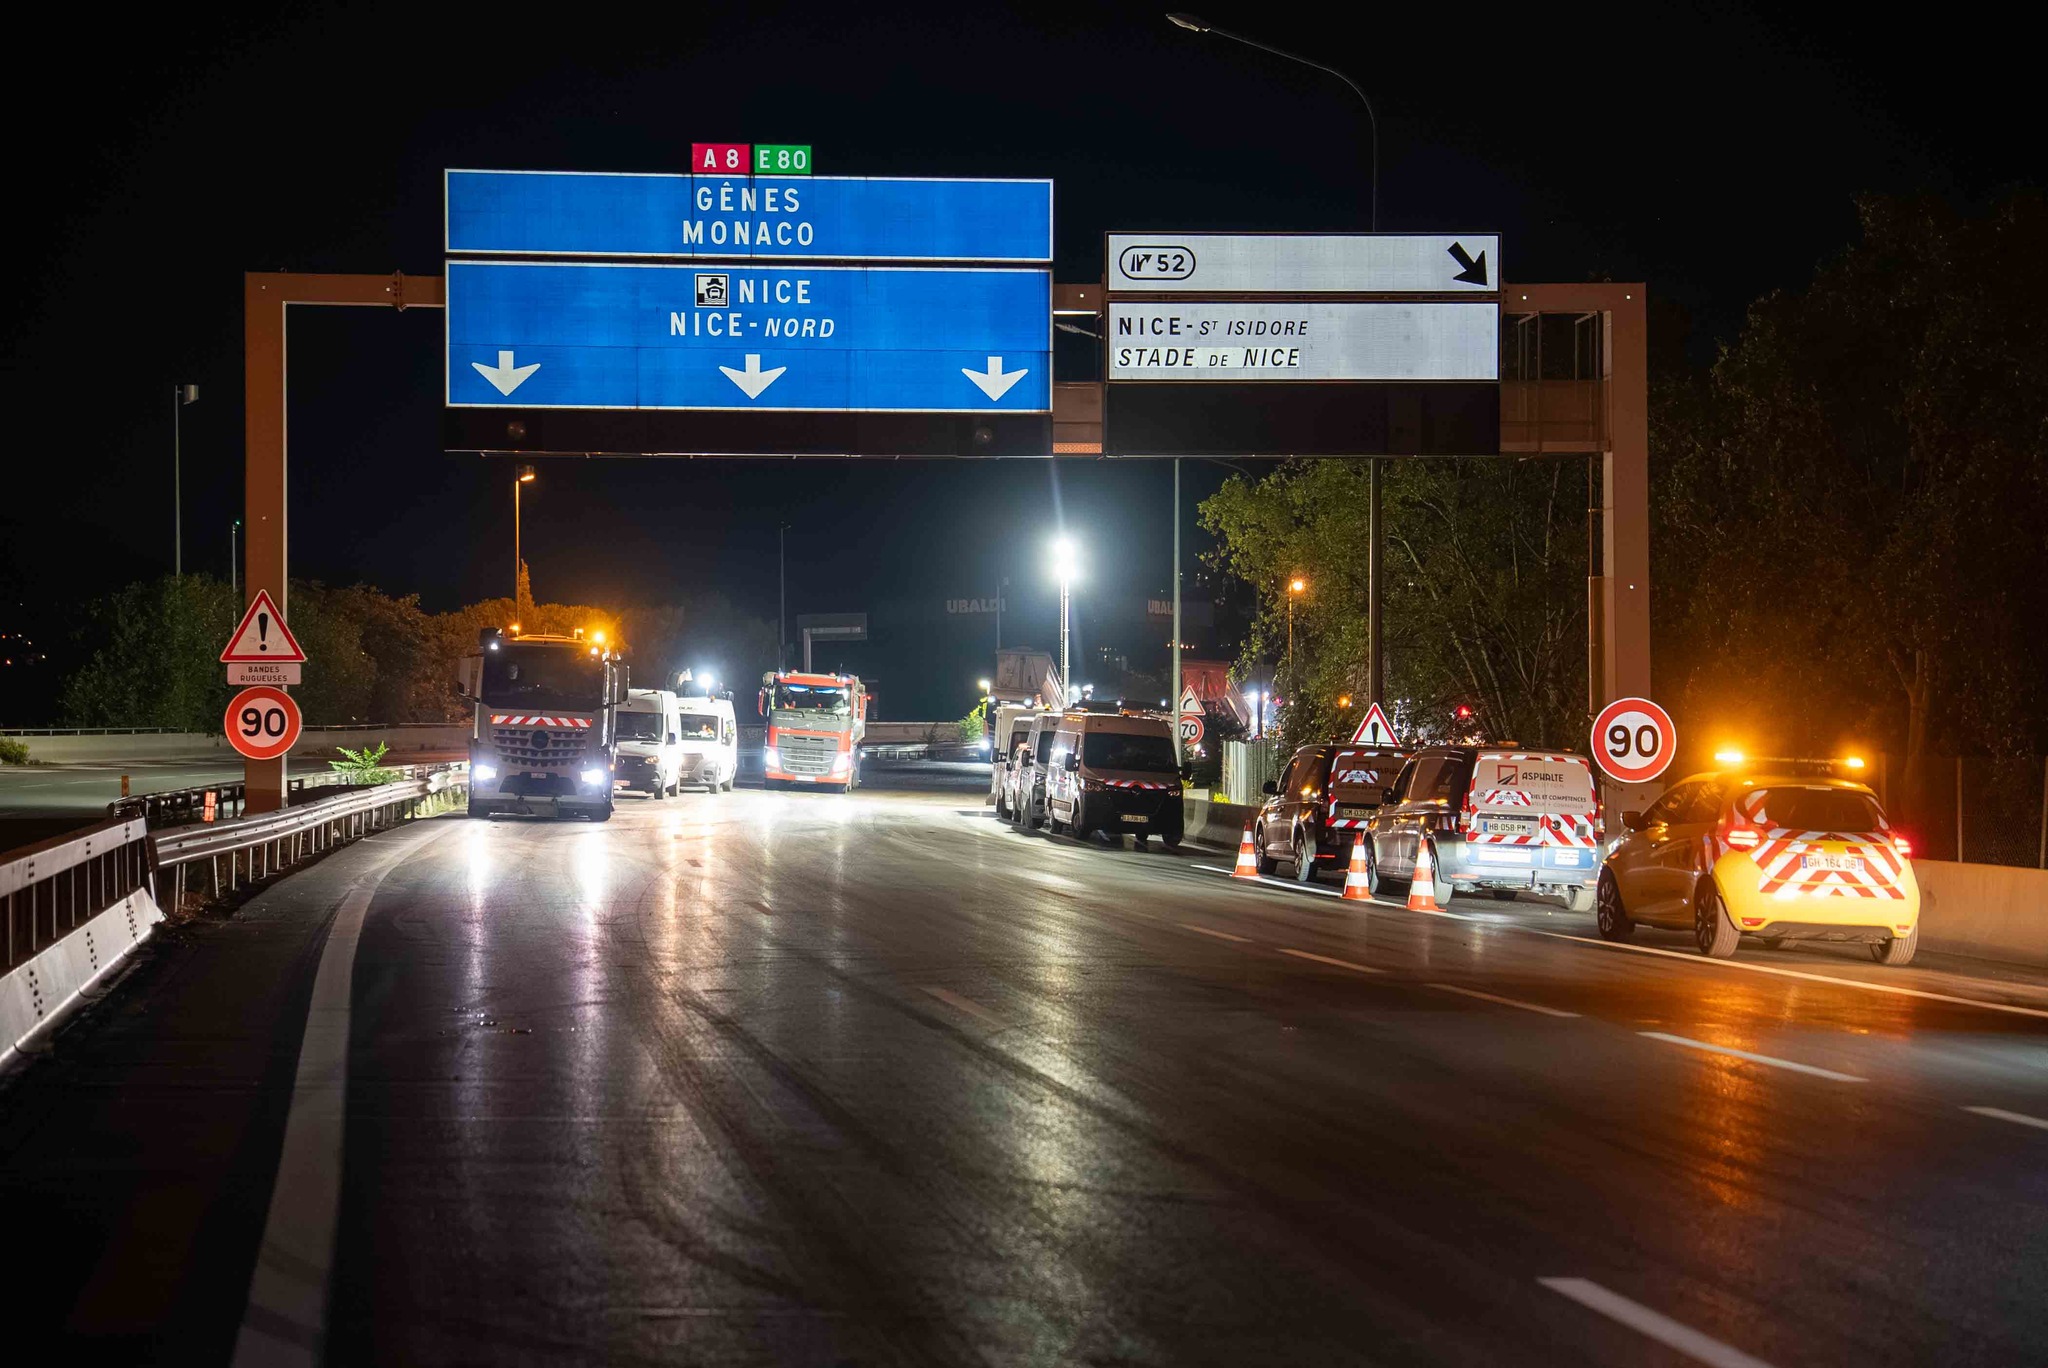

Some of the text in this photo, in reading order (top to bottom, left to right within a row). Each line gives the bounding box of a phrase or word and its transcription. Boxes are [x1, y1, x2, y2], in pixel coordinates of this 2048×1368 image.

[703, 148, 739, 169] A 8
[759, 149, 807, 170] E 80
[696, 181, 800, 213] GÊNES
[682, 220, 814, 246] MONACO
[1157, 254, 1186, 272] 52
[739, 279, 811, 304] NICE
[1227, 320, 1309, 336] ISIDORE
[1118, 348, 1300, 367] STADE DE NICE
[241, 707, 287, 737] 90
[1181, 723, 1198, 737] 70
[1608, 724, 1659, 758] 90
[1521, 771, 1564, 783] ASPHALTE
